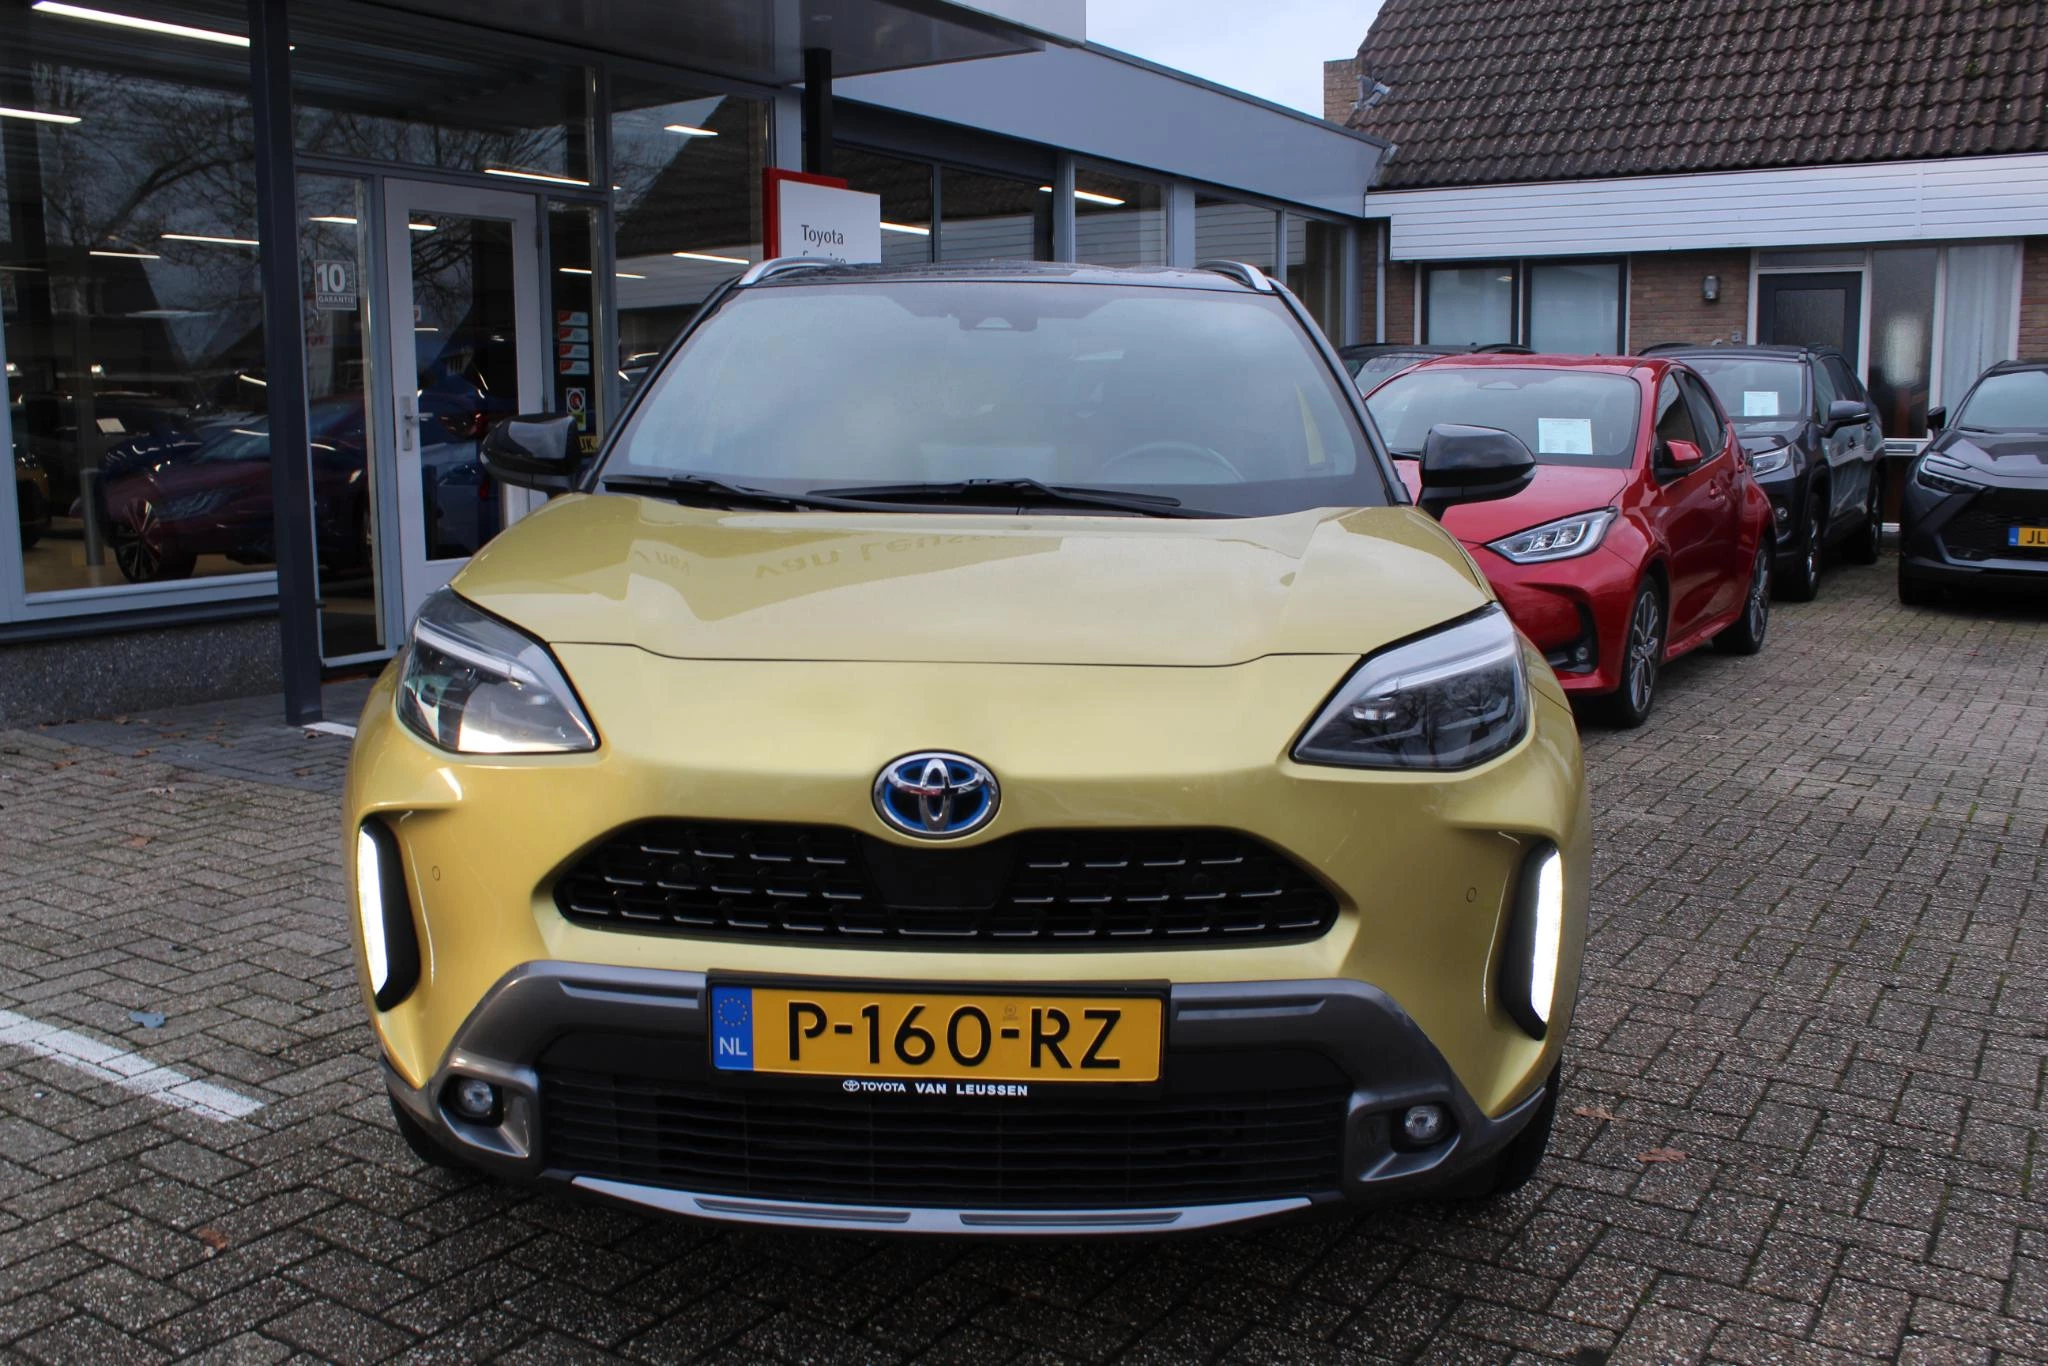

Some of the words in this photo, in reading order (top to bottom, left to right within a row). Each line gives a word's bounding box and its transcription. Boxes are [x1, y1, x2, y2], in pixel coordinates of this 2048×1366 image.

[801, 224, 844, 247] Toyota
[317, 264, 346, 292] 10
[720, 1036, 748, 1056] NL
[788, 1001, 1121, 1069] P-160-RZ
[861, 1081, 906, 1093] TOYOTA
[915, 1083, 947, 1094] VAN
[956, 1084, 1028, 1096] LEUSSEN
